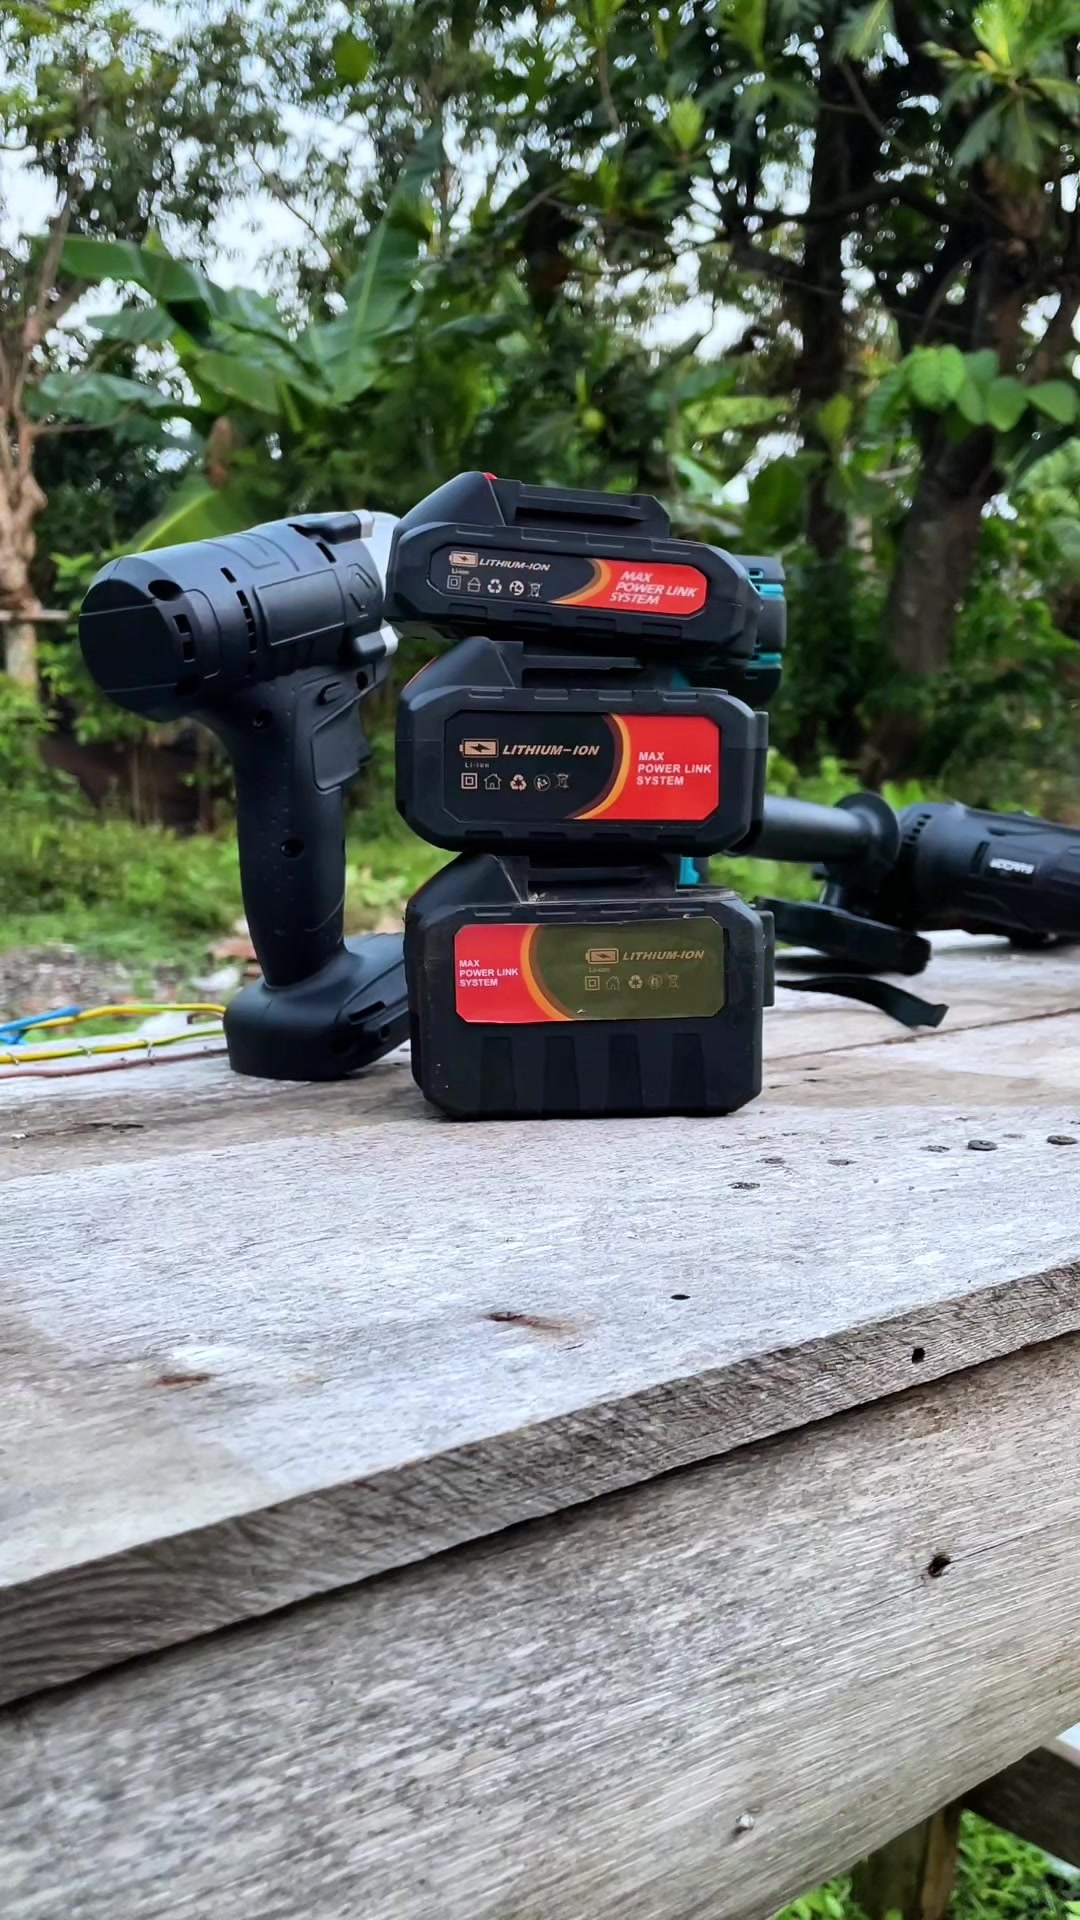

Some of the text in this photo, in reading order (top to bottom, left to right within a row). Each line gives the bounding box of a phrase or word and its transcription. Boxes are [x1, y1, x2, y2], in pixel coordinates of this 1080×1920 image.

[479, 558, 551, 572] LITHIUM-ION
[620, 570, 653, 583] MAX
[616, 581, 698, 598] POWER LINK
[609, 592, 660, 605] SYSTEM
[502, 744, 600, 756] LITHIUM-ION
[639, 751, 664, 761] MAX
[637, 764, 712, 774] POWER LINK
[636, 775, 684, 786] SYSTEM
[622, 950, 705, 961] LITHIUM-ION
[459, 959, 480, 968] MAX
[459, 967, 518, 978] POWER LINK
[459, 978, 499, 988] SYSTEM
